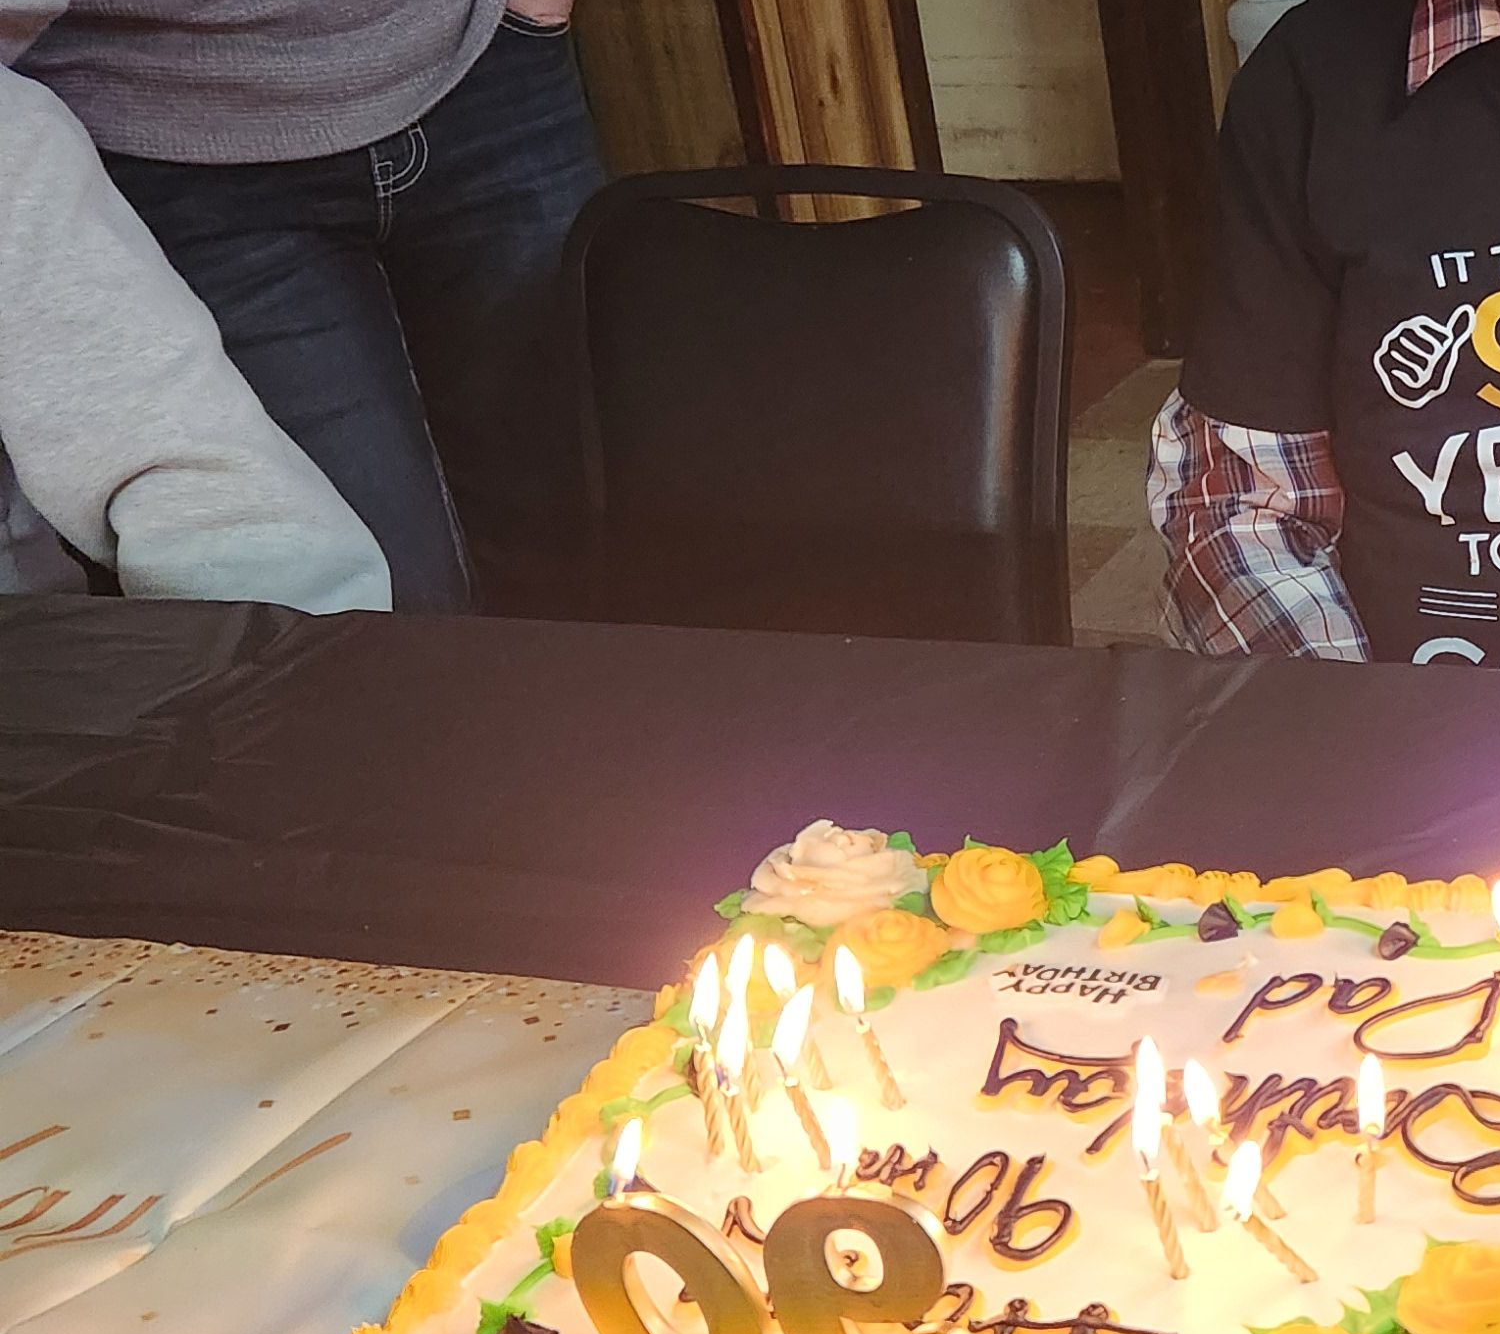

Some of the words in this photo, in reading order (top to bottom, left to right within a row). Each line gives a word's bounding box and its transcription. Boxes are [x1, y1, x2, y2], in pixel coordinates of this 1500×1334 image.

[1430, 250, 1475, 289] IT
[992, 964, 1162, 991] BIRTHDAY
[998, 979, 1127, 1005] HAPPY
